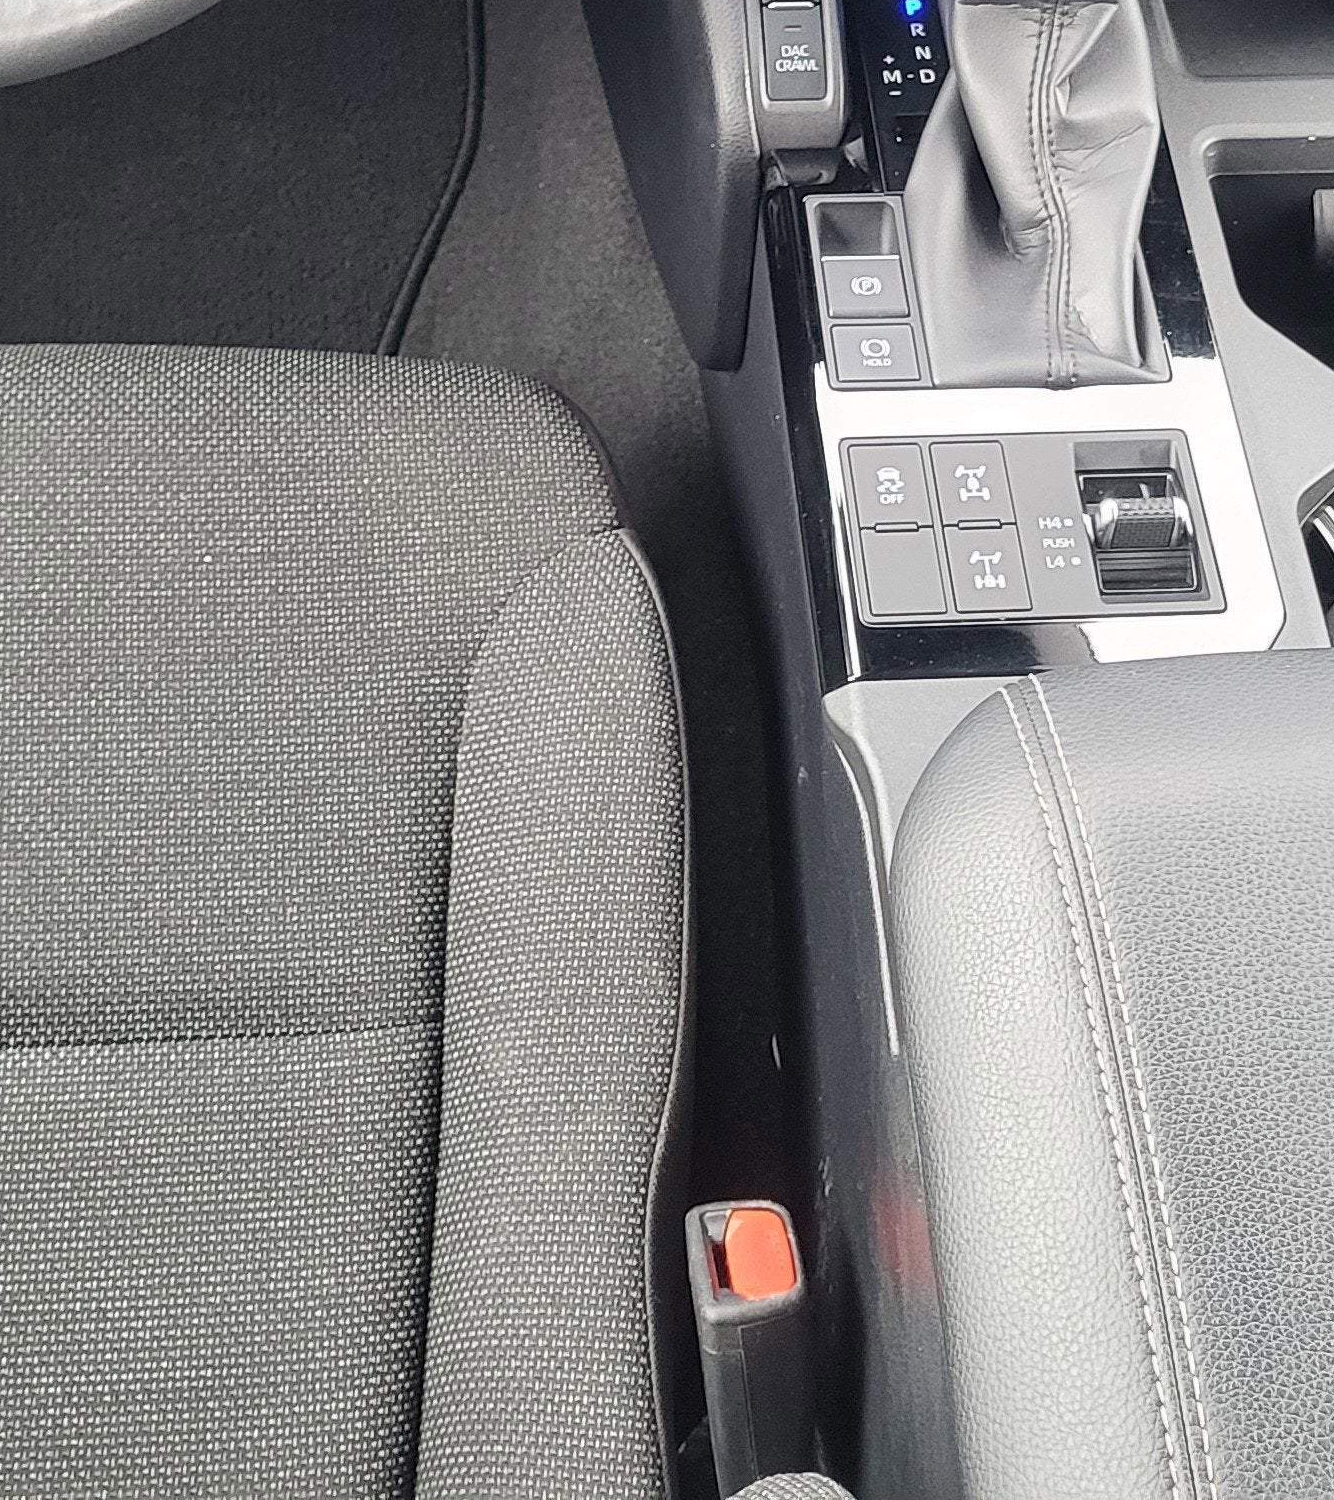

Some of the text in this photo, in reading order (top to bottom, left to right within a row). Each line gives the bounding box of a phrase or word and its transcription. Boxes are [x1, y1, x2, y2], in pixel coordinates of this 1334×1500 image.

[910, 23, 927, 38] R
[781, 45, 810, 57] DAC
[915, 46, 932, 61] N
[775, 58, 819, 72] CRAWL
[882, 69, 936, 85] M D
[863, 358, 892, 367] HOLD
[879, 493, 905, 505] OFF
[1038, 517, 1062, 530] H4
[1042, 537, 1075, 549] PUSH
[1045, 555, 1066, 569] L4
